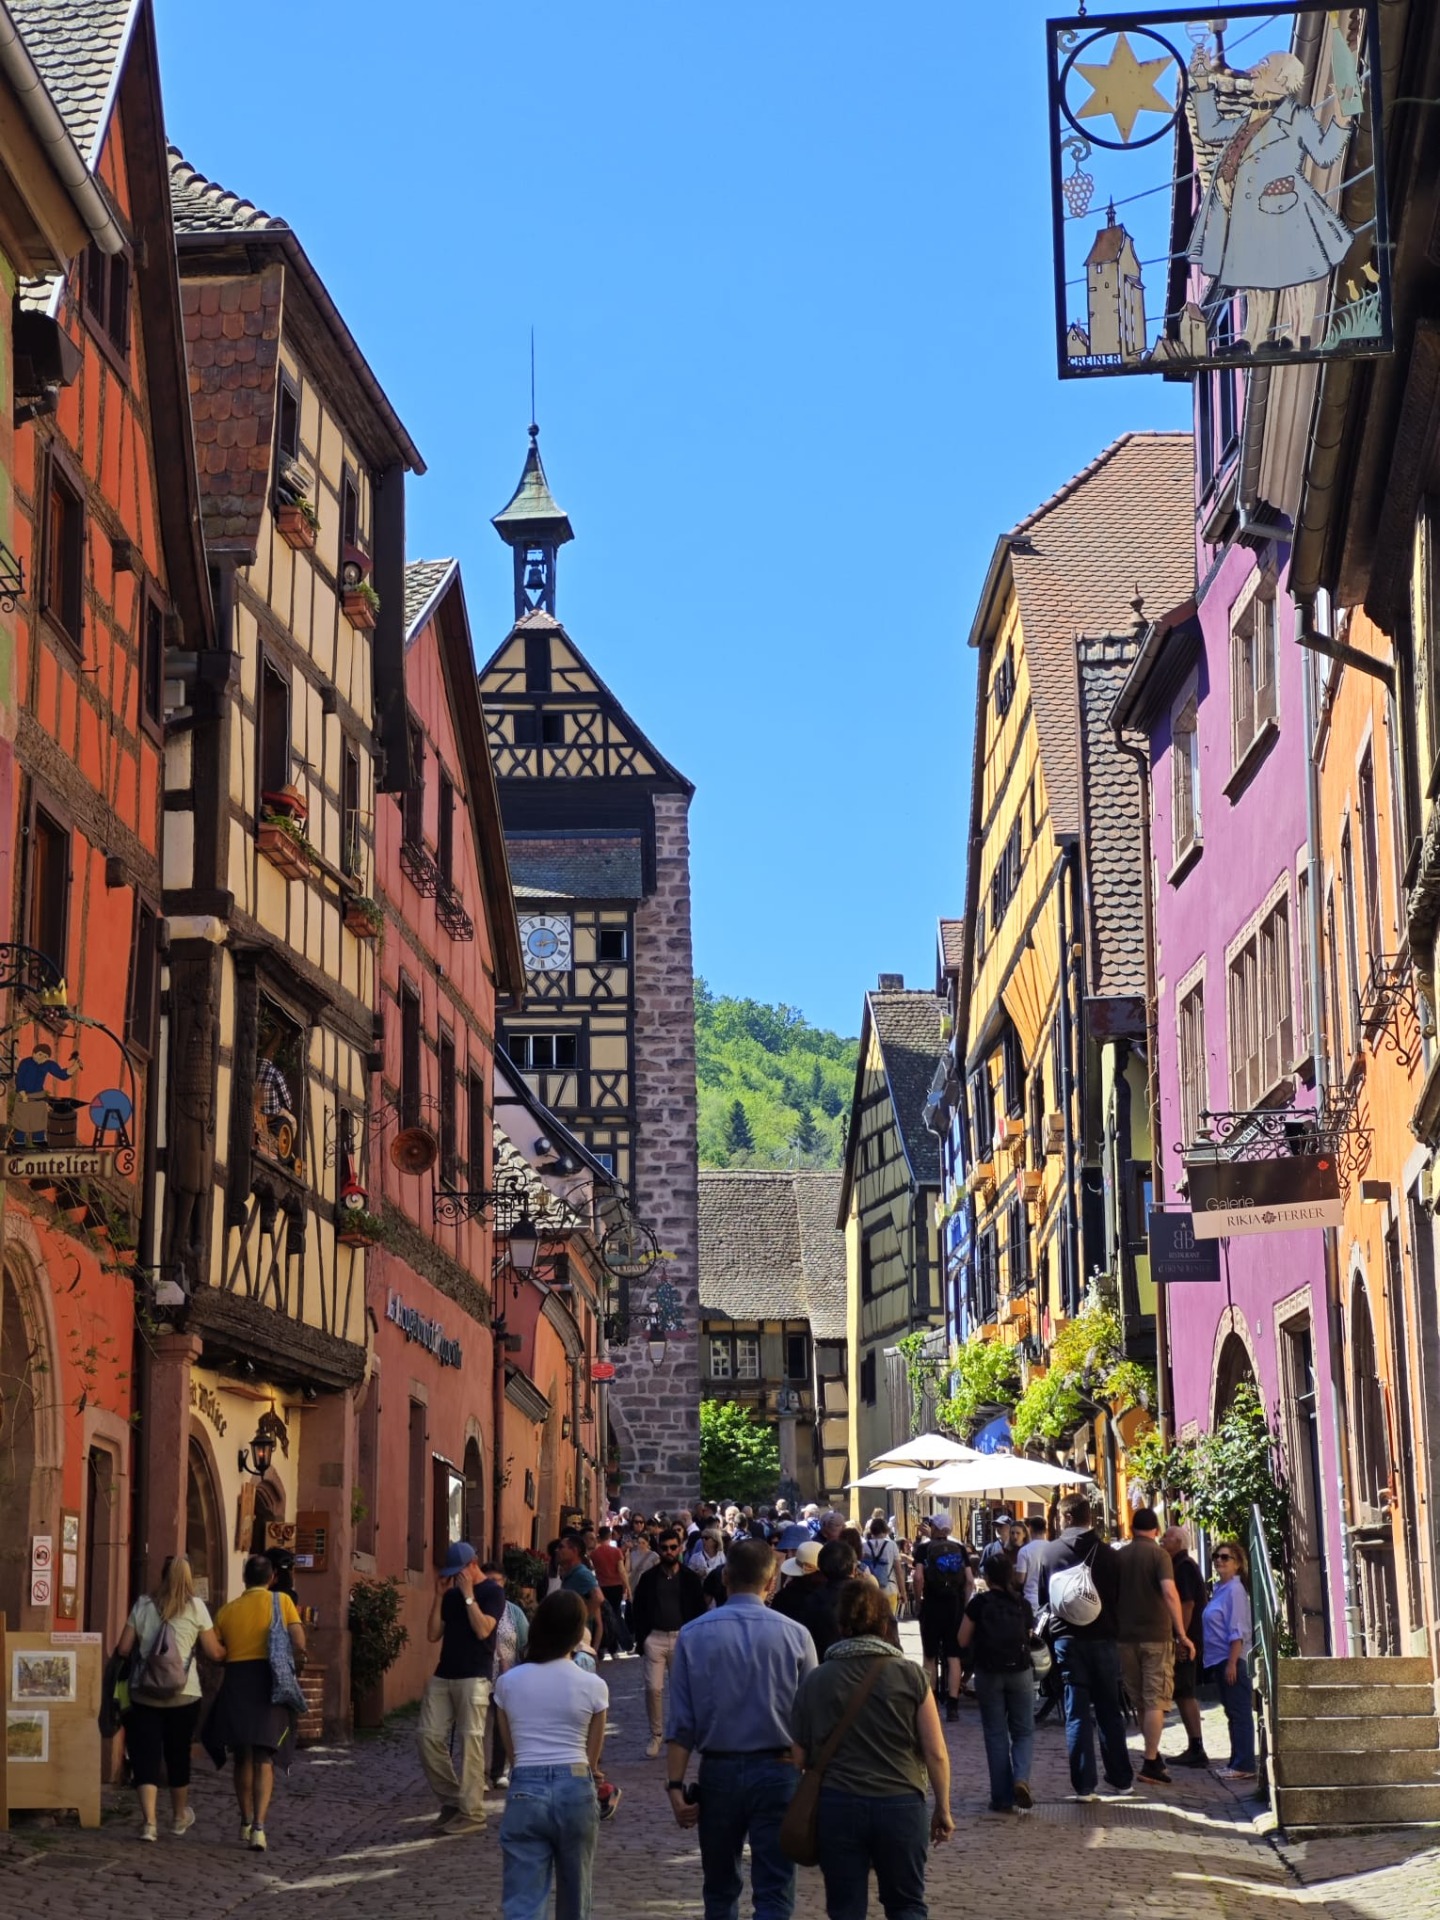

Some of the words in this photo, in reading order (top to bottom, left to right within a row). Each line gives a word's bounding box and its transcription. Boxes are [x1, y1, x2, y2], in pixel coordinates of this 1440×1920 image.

[8, 1154, 99, 1176] Coutelier
[1205, 1195, 1255, 1212] Galerie
[1227, 1212, 1262, 1228] RIKIA
[1277, 1206, 1325, 1223] FERRER
